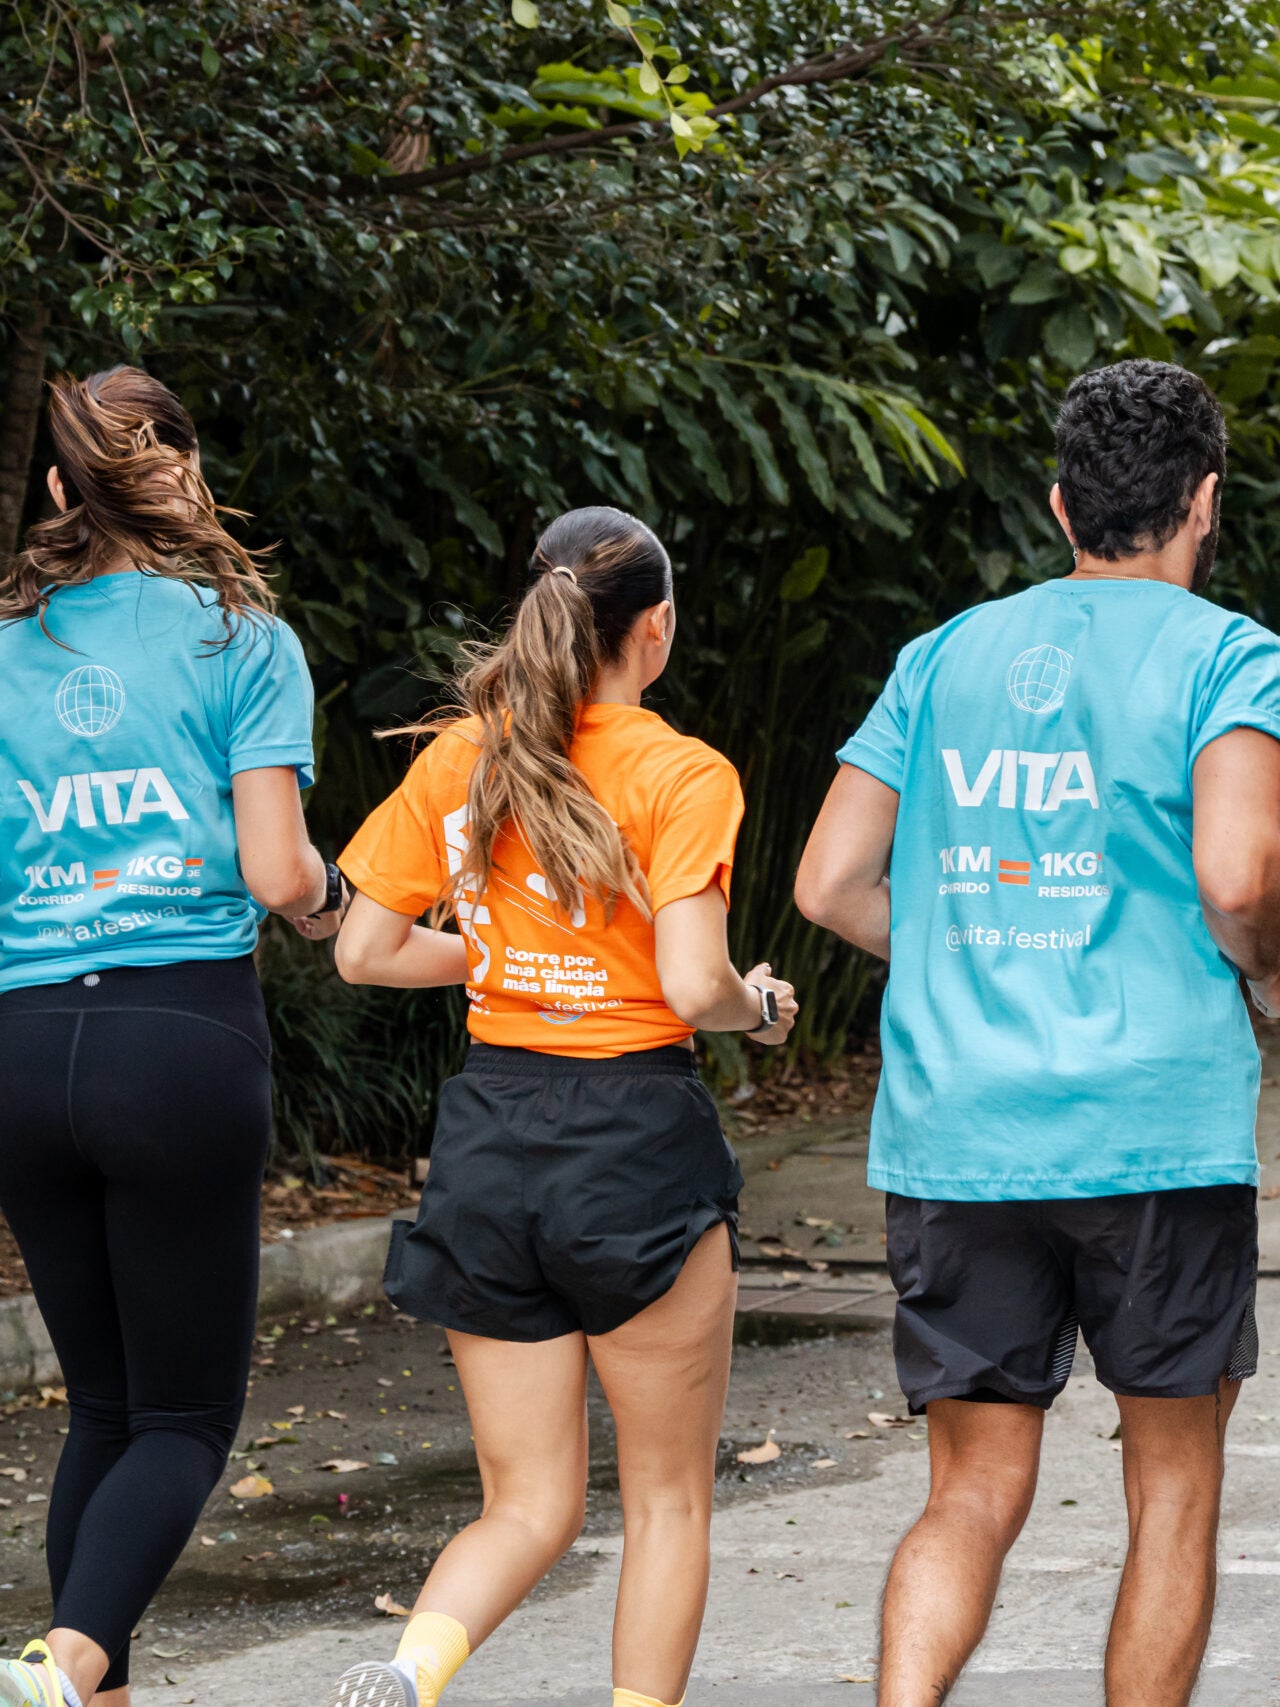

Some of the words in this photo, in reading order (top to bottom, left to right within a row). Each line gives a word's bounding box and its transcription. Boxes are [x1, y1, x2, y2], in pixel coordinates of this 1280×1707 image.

[941, 749, 1099, 811] VITA
[16, 767, 190, 832] VITA
[24, 861, 87, 889] 1KM
[126, 855, 184, 879] 1KG
[939, 846, 991, 874] 1KM
[1039, 851, 1098, 877] 1KG
[18, 893, 85, 906] CORRIDO
[117, 883, 203, 897] RESIDUOS
[938, 882, 991, 897] CRIDO
[945, 923, 1092, 952] @vita.festival
[505, 946, 560, 966] Corre
[564, 954, 596, 968] por
[505, 963, 536, 978] una
[540, 966, 608, 982] ciudad
[502, 977, 541, 993] más
[545, 980, 605, 998] limpia
